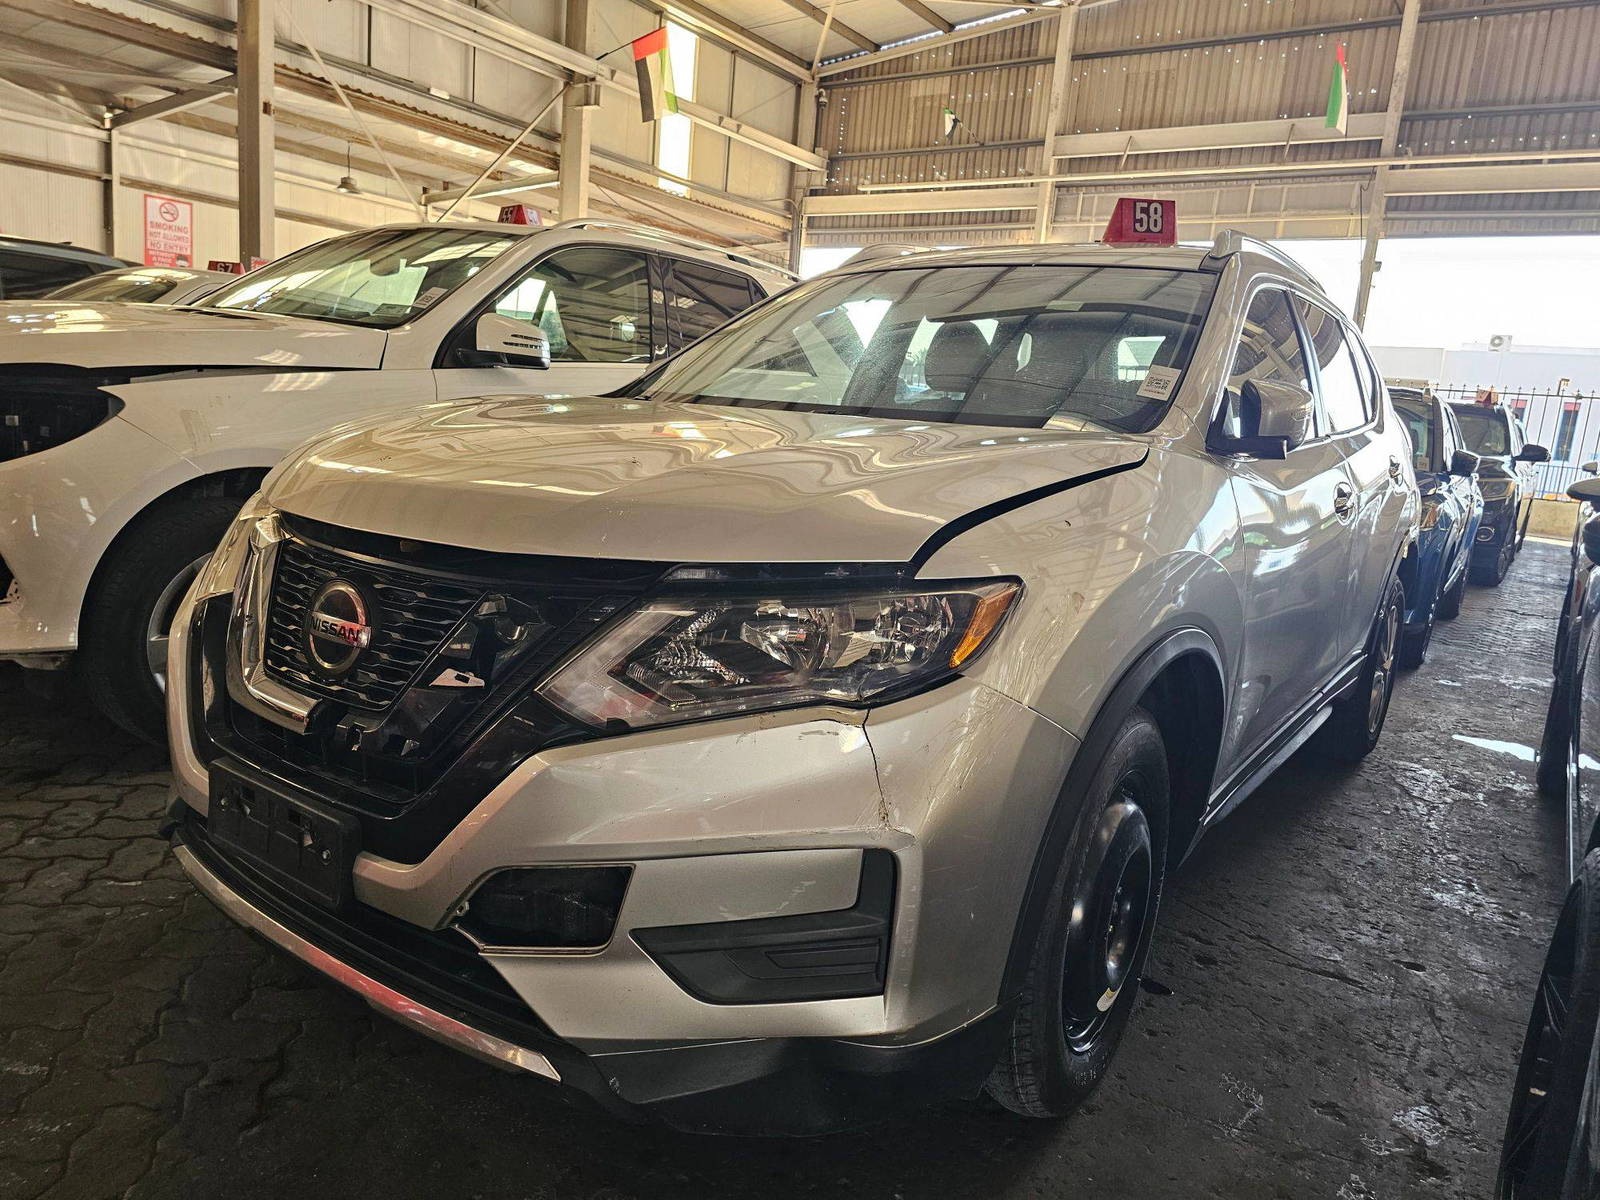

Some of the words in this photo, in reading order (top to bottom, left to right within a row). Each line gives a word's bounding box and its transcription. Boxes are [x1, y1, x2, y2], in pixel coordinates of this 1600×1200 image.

[1134, 202, 1162, 233] 58
[150, 221, 189, 235] SMOKING
[149, 231, 161, 239] NOT
[150, 240, 162, 249] NO
[163, 243, 188, 253] ENTRY
[216, 262, 233, 273] 67
[311, 616, 360, 643] NISSAN
